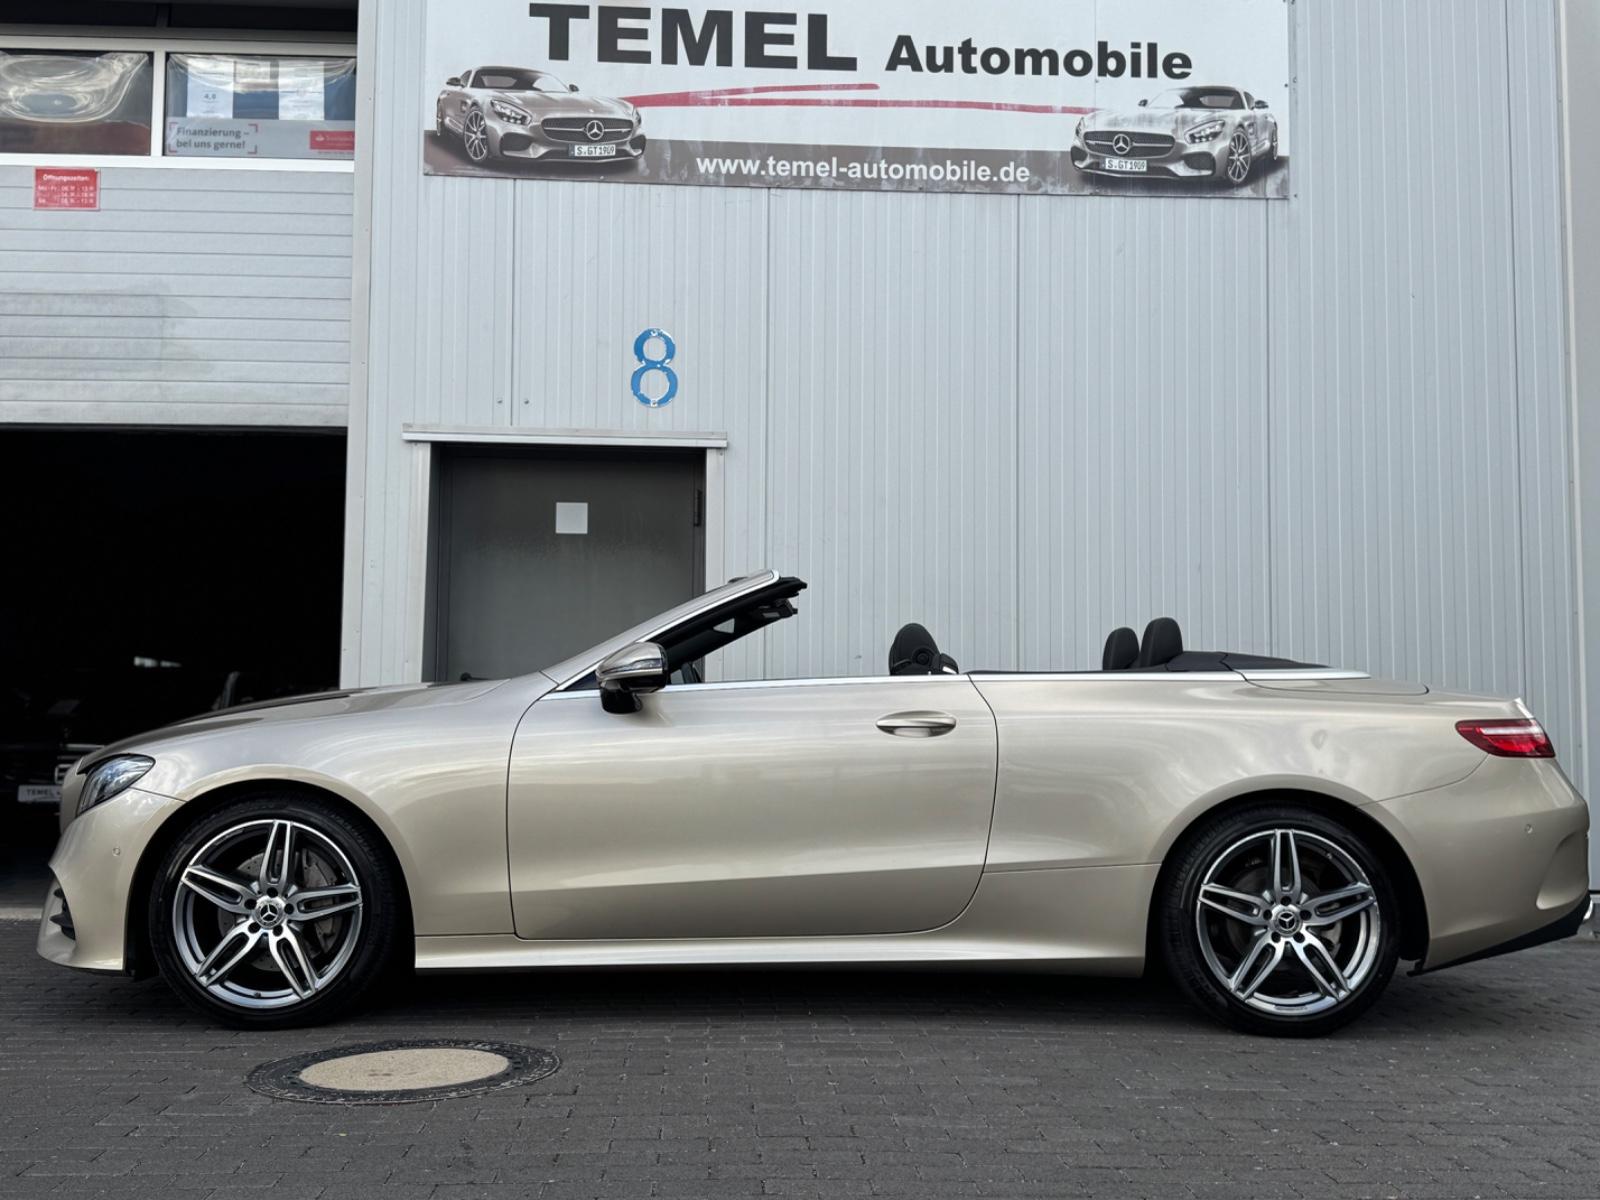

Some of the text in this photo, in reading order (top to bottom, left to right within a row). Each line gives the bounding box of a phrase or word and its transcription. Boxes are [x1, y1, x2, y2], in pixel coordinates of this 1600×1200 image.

[529, 3, 1192, 80] TEMEL Automobile
[176, 125, 242, 139] Finanzierung
[194, 141, 212, 149] uns
[213, 140, 246, 151] gerne!
[696, 154, 1030, 184] www.temel-automobile.de
[630, 328, 678, 408] 8
